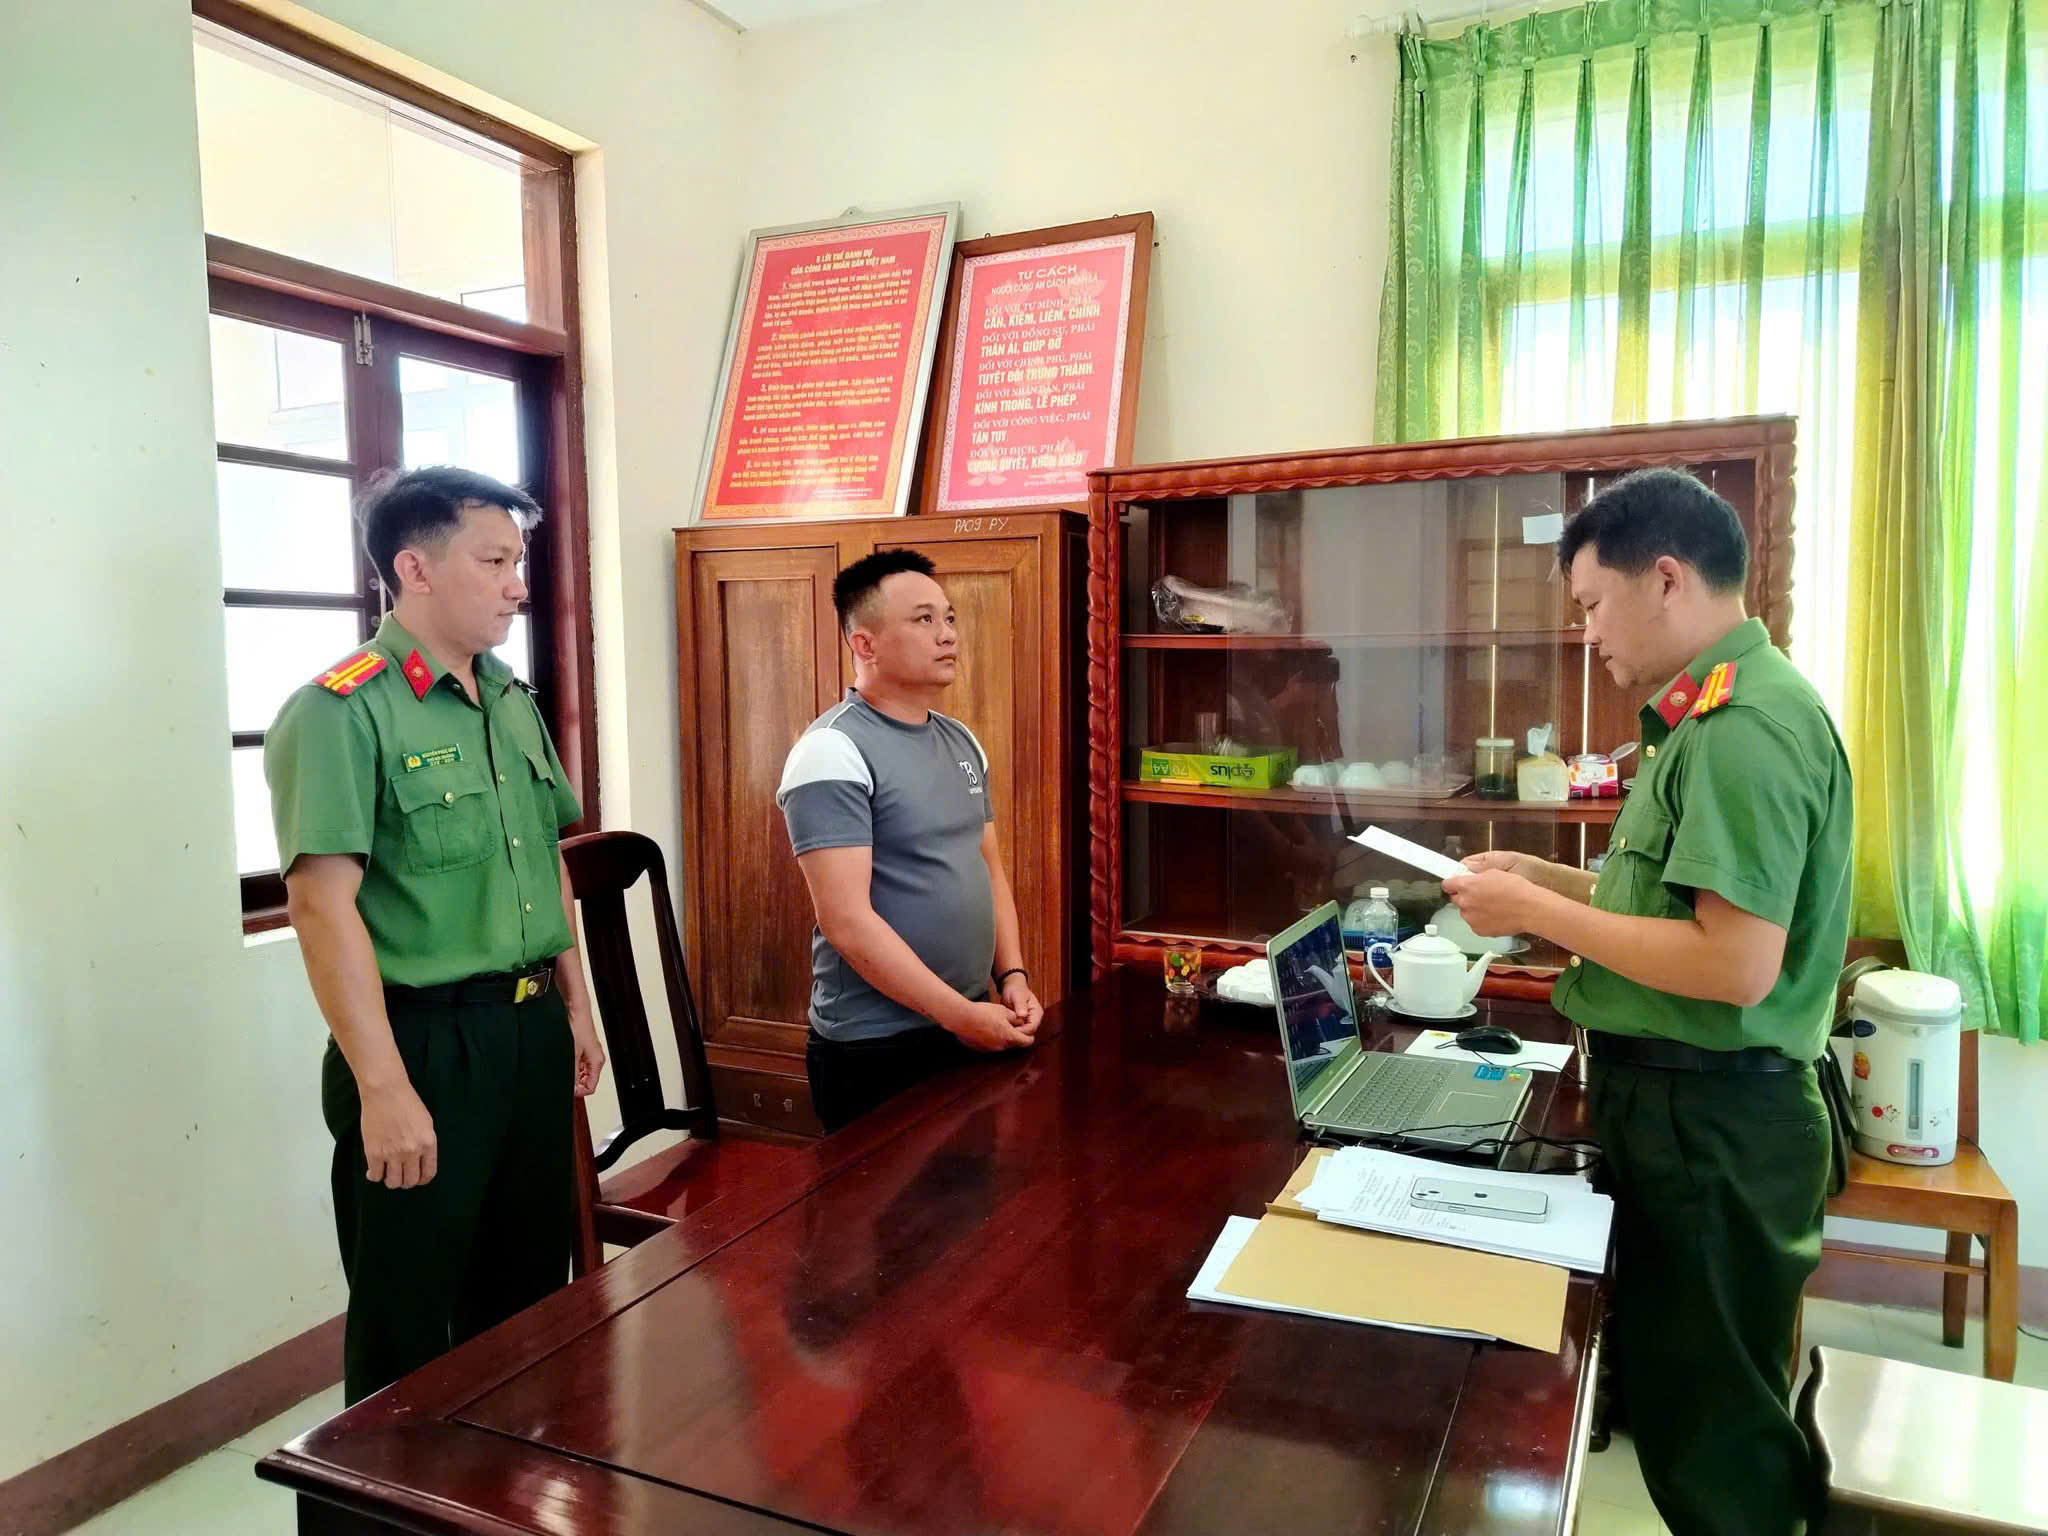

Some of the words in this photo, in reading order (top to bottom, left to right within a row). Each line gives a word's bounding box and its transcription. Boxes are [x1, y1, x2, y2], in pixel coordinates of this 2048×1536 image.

[844, 249, 862, 260] DANH
[880, 255, 896, 265] NAM
[1035, 264, 1077, 278] CÁCH
[1035, 280, 1046, 290] AN
[1046, 276, 1066, 289] CÁCH
[1001, 329, 1019, 341] VỚI
[1070, 320, 1095, 334] PHẢI
[1022, 338, 1046, 353] GIÚP
[997, 357, 1013, 369] VỚI
[1069, 348, 1092, 362] PHẢI
[978, 371, 1006, 386] TUYỆT
[1026, 366, 1059, 381] TRUNG
[994, 387, 1010, 398] VỚI
[1062, 379, 1086, 392] PHẢI
[974, 399, 998, 414] KÍNH
[992, 416, 1009, 428] VỚI
[1010, 414, 1038, 426] CÔNG
[1066, 410, 1091, 422] PHẢI
[1152, 763, 1169, 777] A4
[1210, 763, 1242, 781] plus
